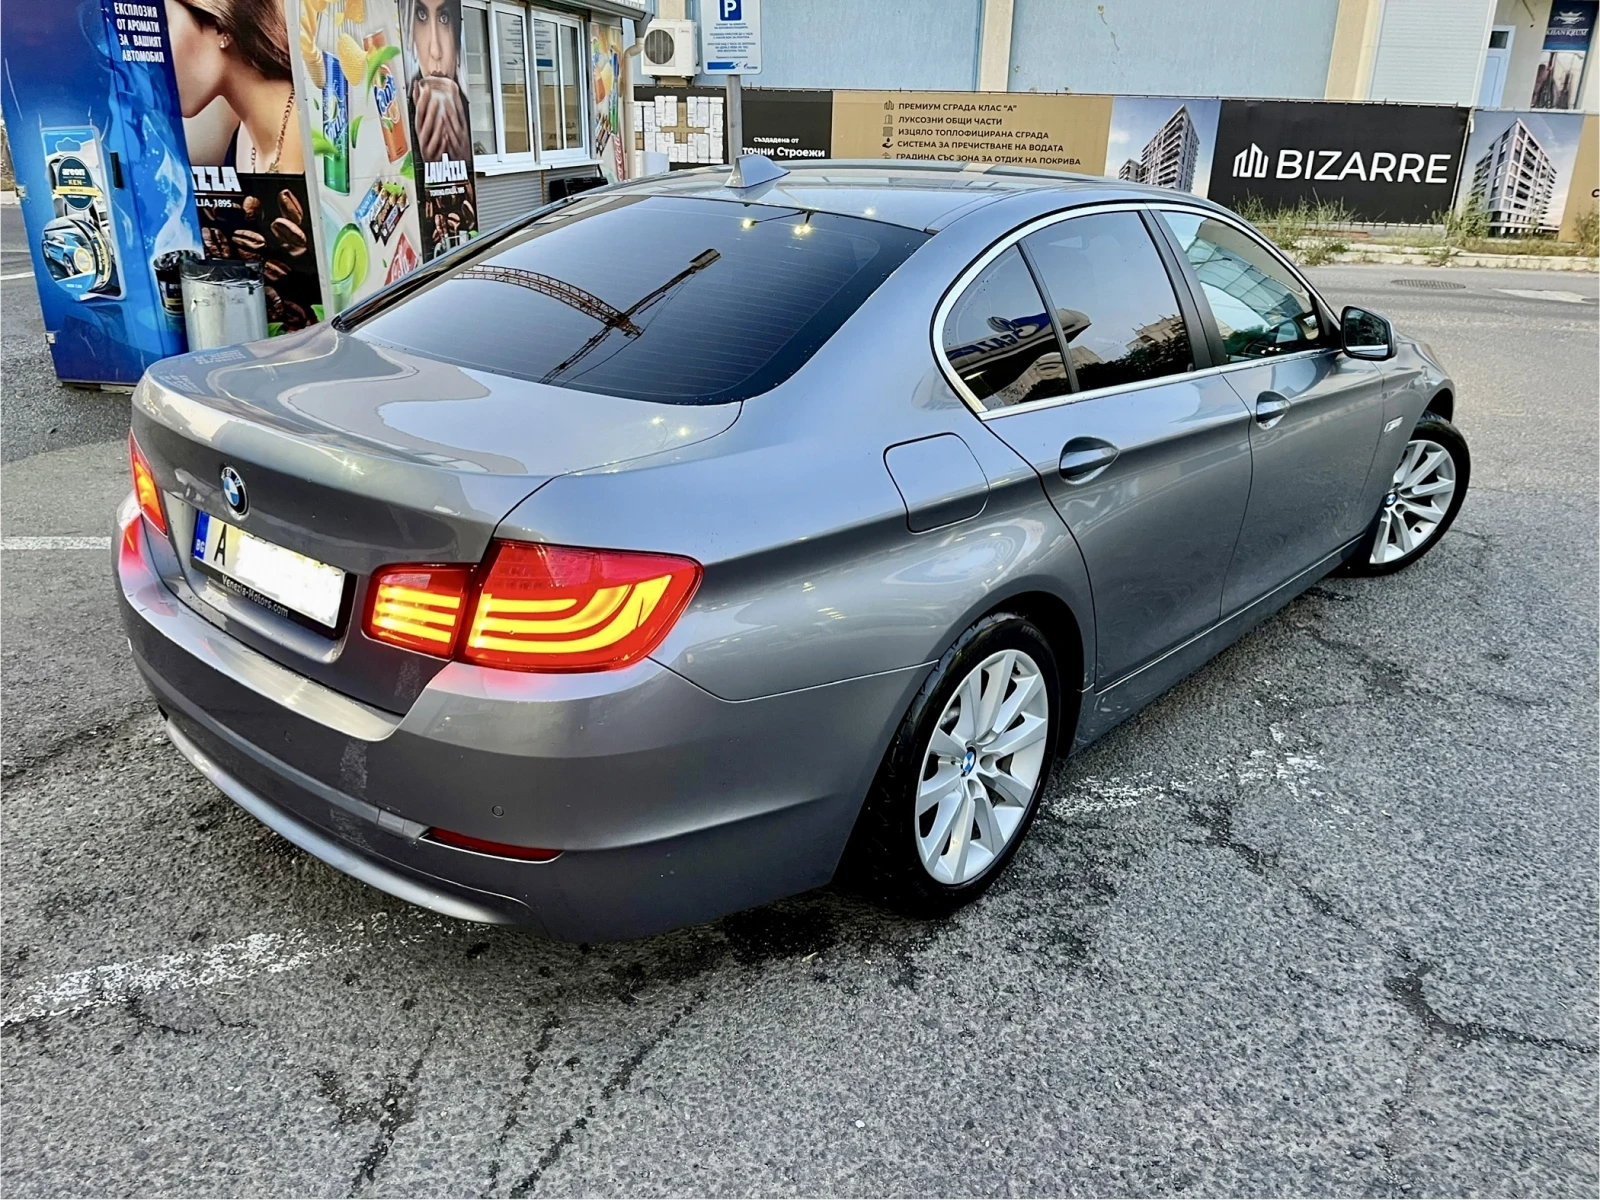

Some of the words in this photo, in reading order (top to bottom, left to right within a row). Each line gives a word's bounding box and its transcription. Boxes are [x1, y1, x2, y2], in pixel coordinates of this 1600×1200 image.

[113, 2, 158, 18] ЕКСПЛОЗИЯ
[116, 18, 126, 30] ОТ
[127, 19, 160, 33] АРОМАТИ
[118, 34, 129, 46] ЗА
[132, 35, 162, 48] ВАШИЯТ
[122, 49, 165, 63] АВТОМОБИЛ
[898, 102, 941, 110] ПРЕМИУМ
[942, 103, 976, 112] СГРАДА
[978, 104, 1002, 112] КЛАС
[898, 116, 944, 124] ЛУКСОЗНИ
[945, 117, 972, 126] ОБЩИ
[974, 118, 1003, 126] ЧАСТИ
[753, 136, 790, 144] създадена
[898, 128, 933, 137] ИЗЦЯЛО
[935, 129, 1014, 138] ТОПЛОФИЦИРАНА
[1015, 131, 1049, 140] СГРАДА
[742, 147, 775, 157] точни
[776, 146, 826, 159] Строежи
[897, 140, 937, 148] СИСТЕМА
[938, 141, 950, 149] ЗА
[951, 141, 1013, 151] ПРЕЧИСТВАНЕ
[1014, 143, 1027, 151] НА
[1028, 144, 1064, 153] ВОДАТА
[956, 154, 980, 162] ЗОНА
[981, 155, 993, 163] ЗА
[994, 155, 1024, 164] ОТДИХ
[1025, 156, 1038, 164] НА
[1039, 157, 1081, 166] ПОКРИВА
[1276, 149, 1451, 183] BIZARRE
[424, 152, 469, 184] LAVAZZA
[213, 199, 233, 208] 1895
[196, 539, 206, 553] BG
[213, 524, 227, 566] A
[222, 575, 289, 618] Venezia-Motors.com
